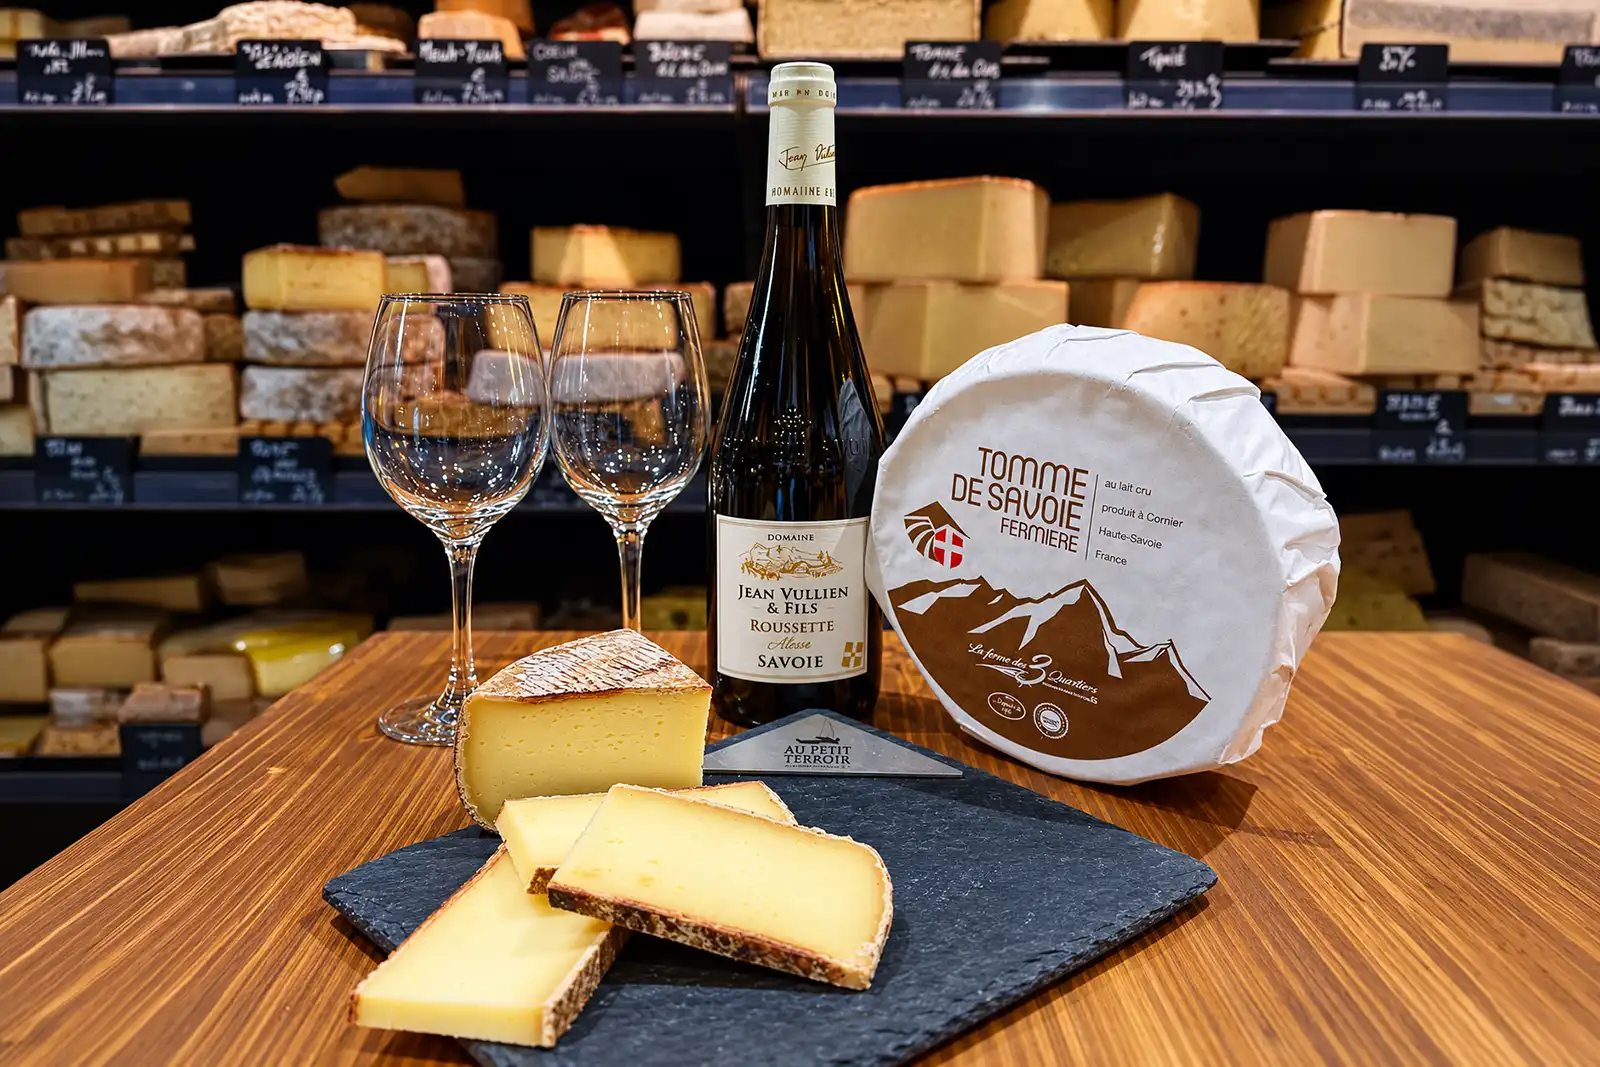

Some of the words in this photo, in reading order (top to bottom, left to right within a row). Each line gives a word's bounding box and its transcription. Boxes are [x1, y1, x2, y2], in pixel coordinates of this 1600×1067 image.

[978, 446, 1089, 500] TOMME
[1104, 480, 1117, 490] au
[1118, 481, 1134, 493] lait
[1135, 485, 1152, 497] cru
[951, 473, 984, 507] DE
[987, 482, 1084, 532] SAVOIE
[1101, 503, 1136, 519] produit
[1137, 509, 1144, 520] à
[1146, 512, 1184, 529] Cornier
[767, 533, 815, 541] DOMAINE
[1000, 517, 1080, 554] FERMIERE
[1098, 526, 1163, 550] Haute-Savoie
[1095, 549, 1128, 566] France
[738, 584, 775, 600] JEAN
[780, 586, 849, 601] VULLIEN
[767, 602, 779, 614] &
[784, 601, 818, 615] FILS
[750, 618, 834, 634] ROUSSETTE
[968, 643, 984, 655] La
[758, 654, 824, 669] SAVOIE
[1011, 657, 1028, 669] des
[1016, 654, 1053, 686] 3
[1047, 670, 1099, 694] Quartiers
[784, 745, 806, 754] AU
[810, 745, 852, 755] PETIT
[784, 754, 851, 765] TERROIR
